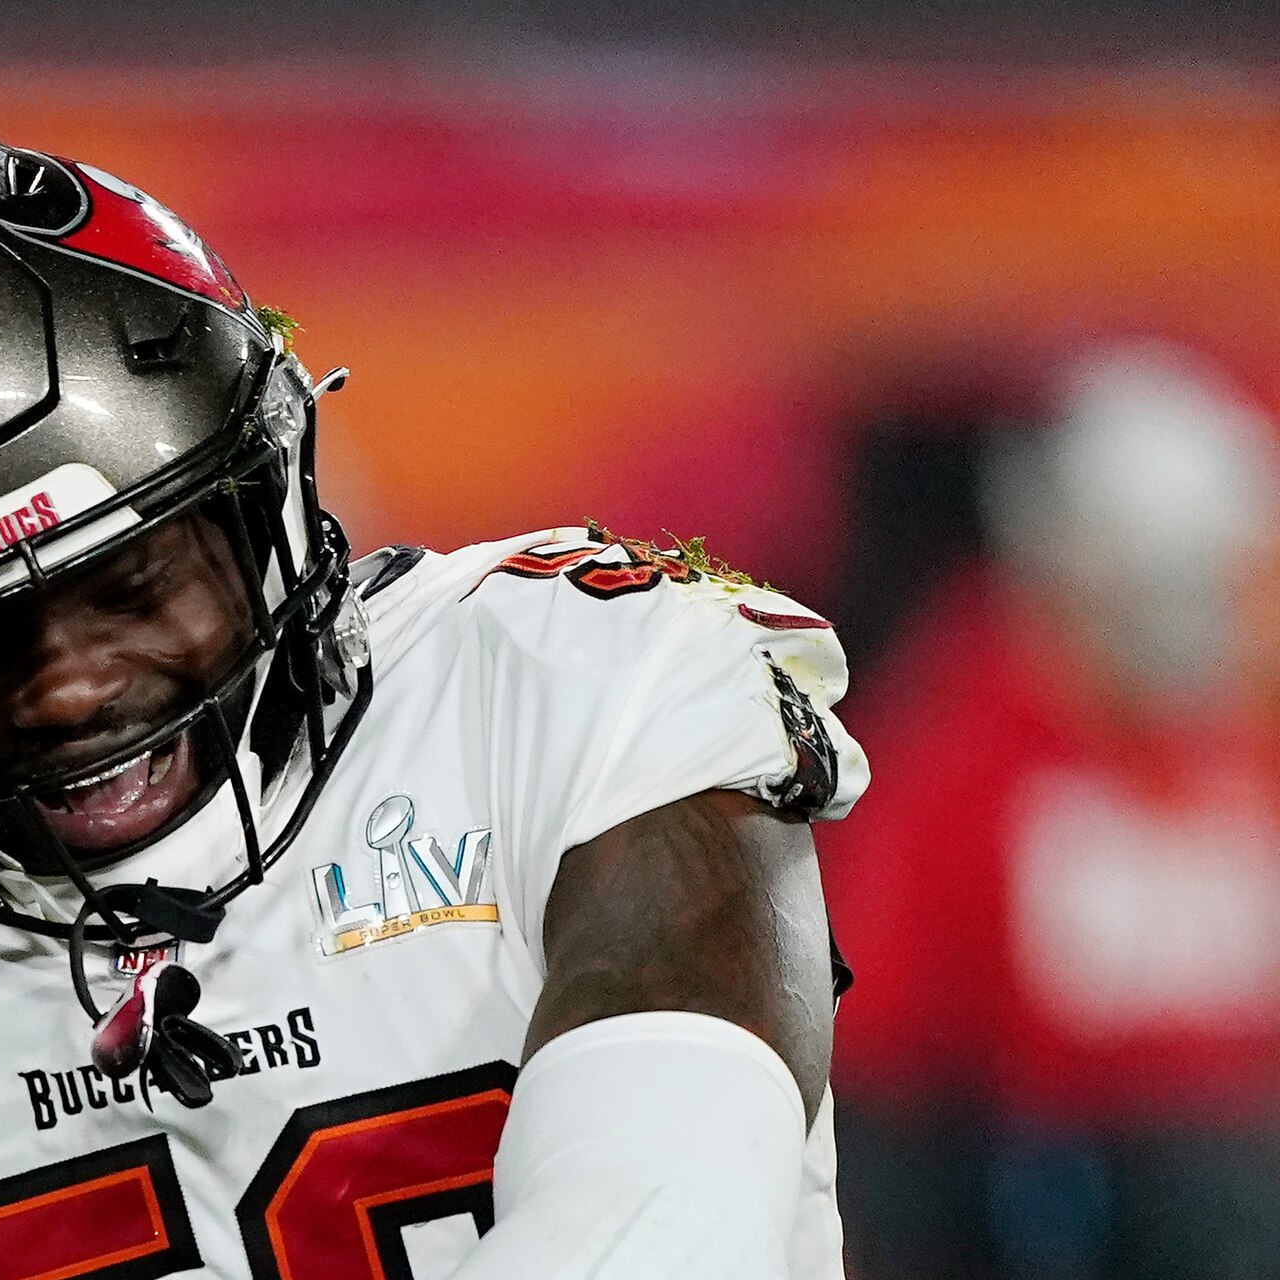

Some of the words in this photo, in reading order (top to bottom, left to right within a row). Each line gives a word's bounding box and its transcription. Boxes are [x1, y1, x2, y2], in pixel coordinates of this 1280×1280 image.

[359, 917, 411, 942] SUPER
[419, 908, 467, 924] BOWL
[18, 1006, 321, 1131] BUCCERS
